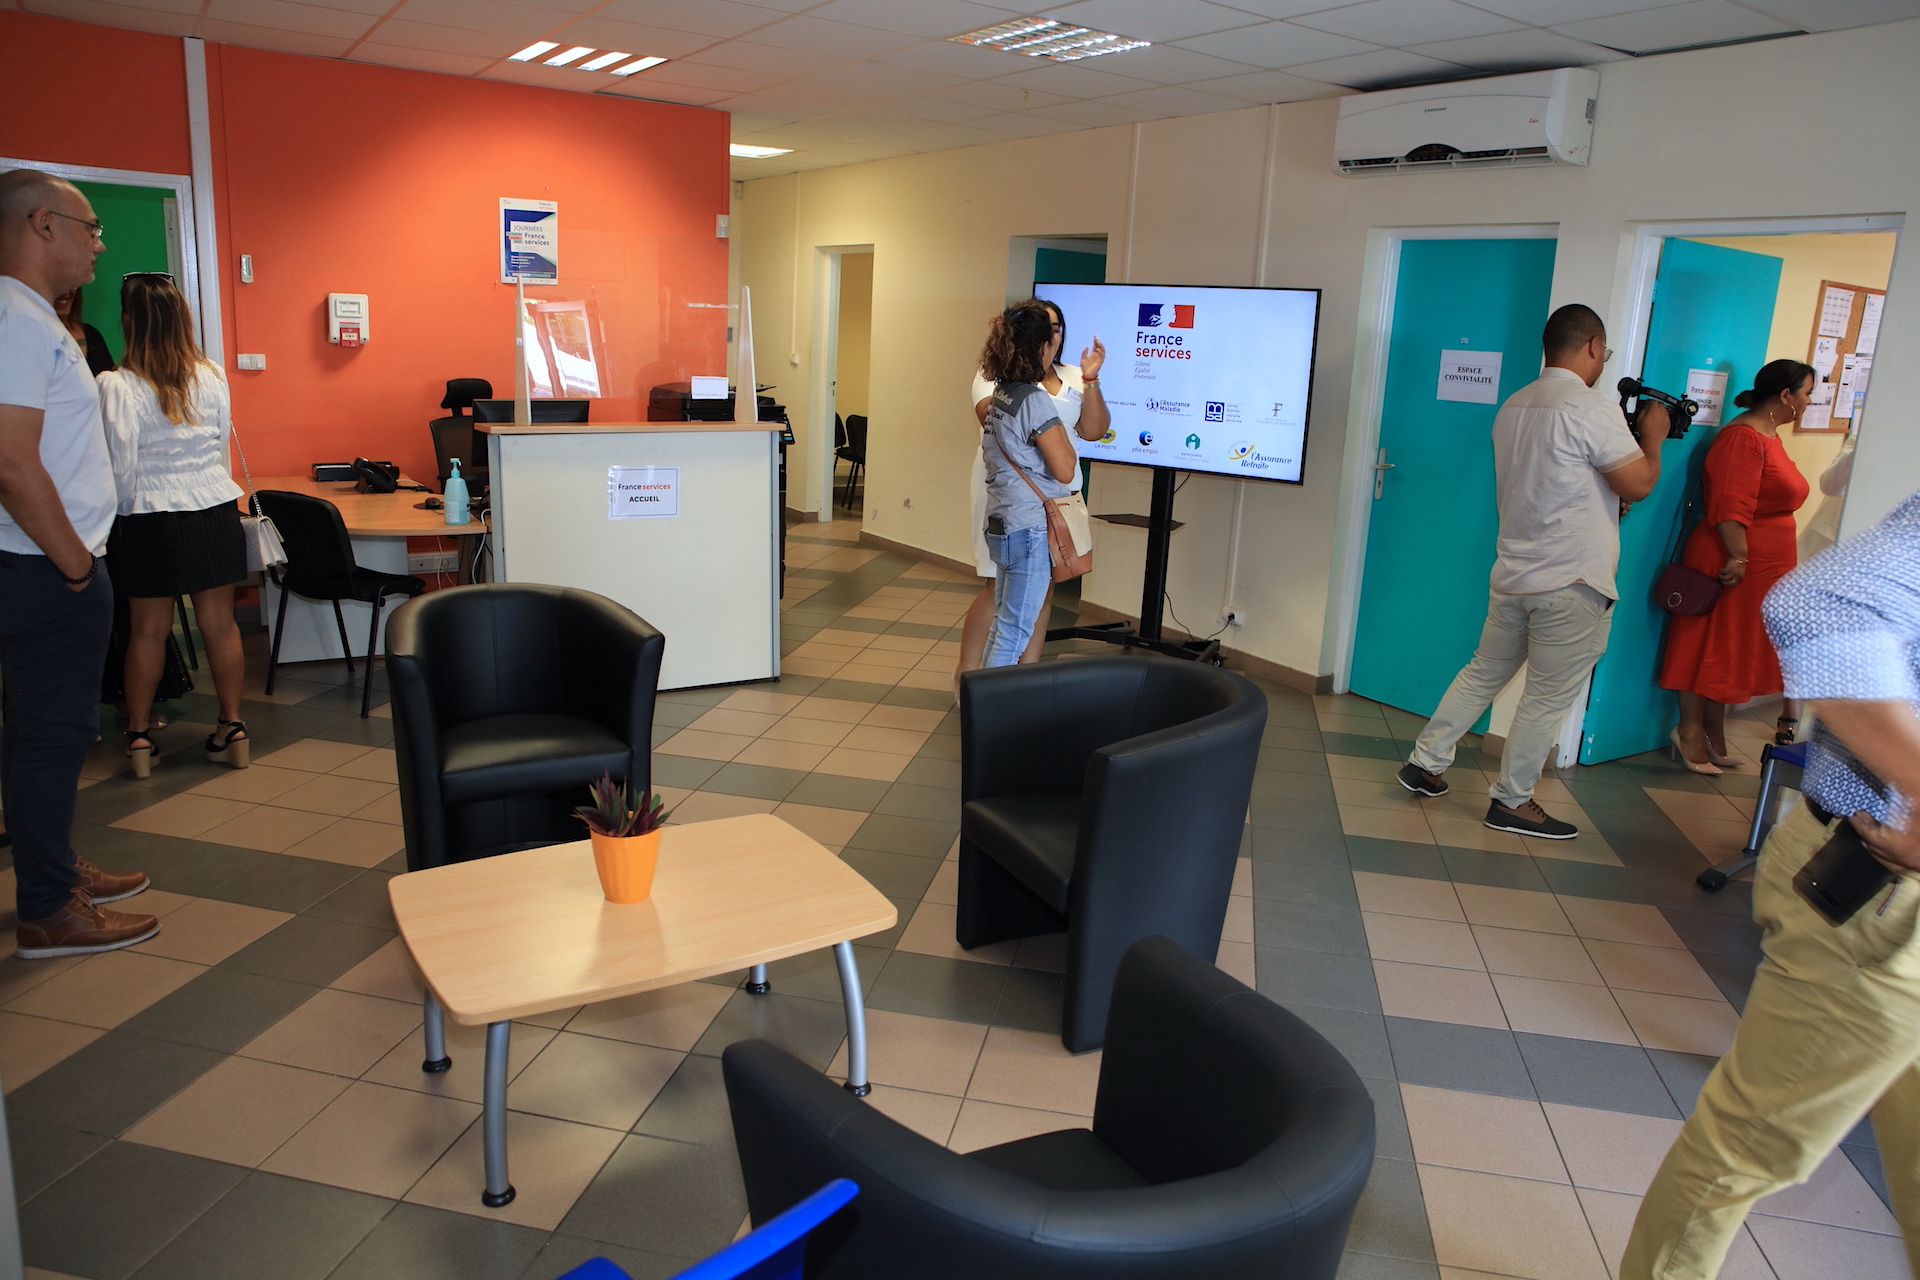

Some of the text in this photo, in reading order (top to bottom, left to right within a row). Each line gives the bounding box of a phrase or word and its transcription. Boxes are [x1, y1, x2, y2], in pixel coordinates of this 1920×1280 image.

[1136, 331, 1183, 346] France
[1135, 345, 1192, 360] services
[1457, 366, 1483, 375] ESPACE
[1444, 374, 1493, 384] CONVIVIALITÉ
[1691, 386, 1721, 396] France services
[1160, 399, 1190, 408] l'Assurance
[1250, 452, 1292, 465] l'Assurance
[1240, 460, 1270, 470] Retraite
